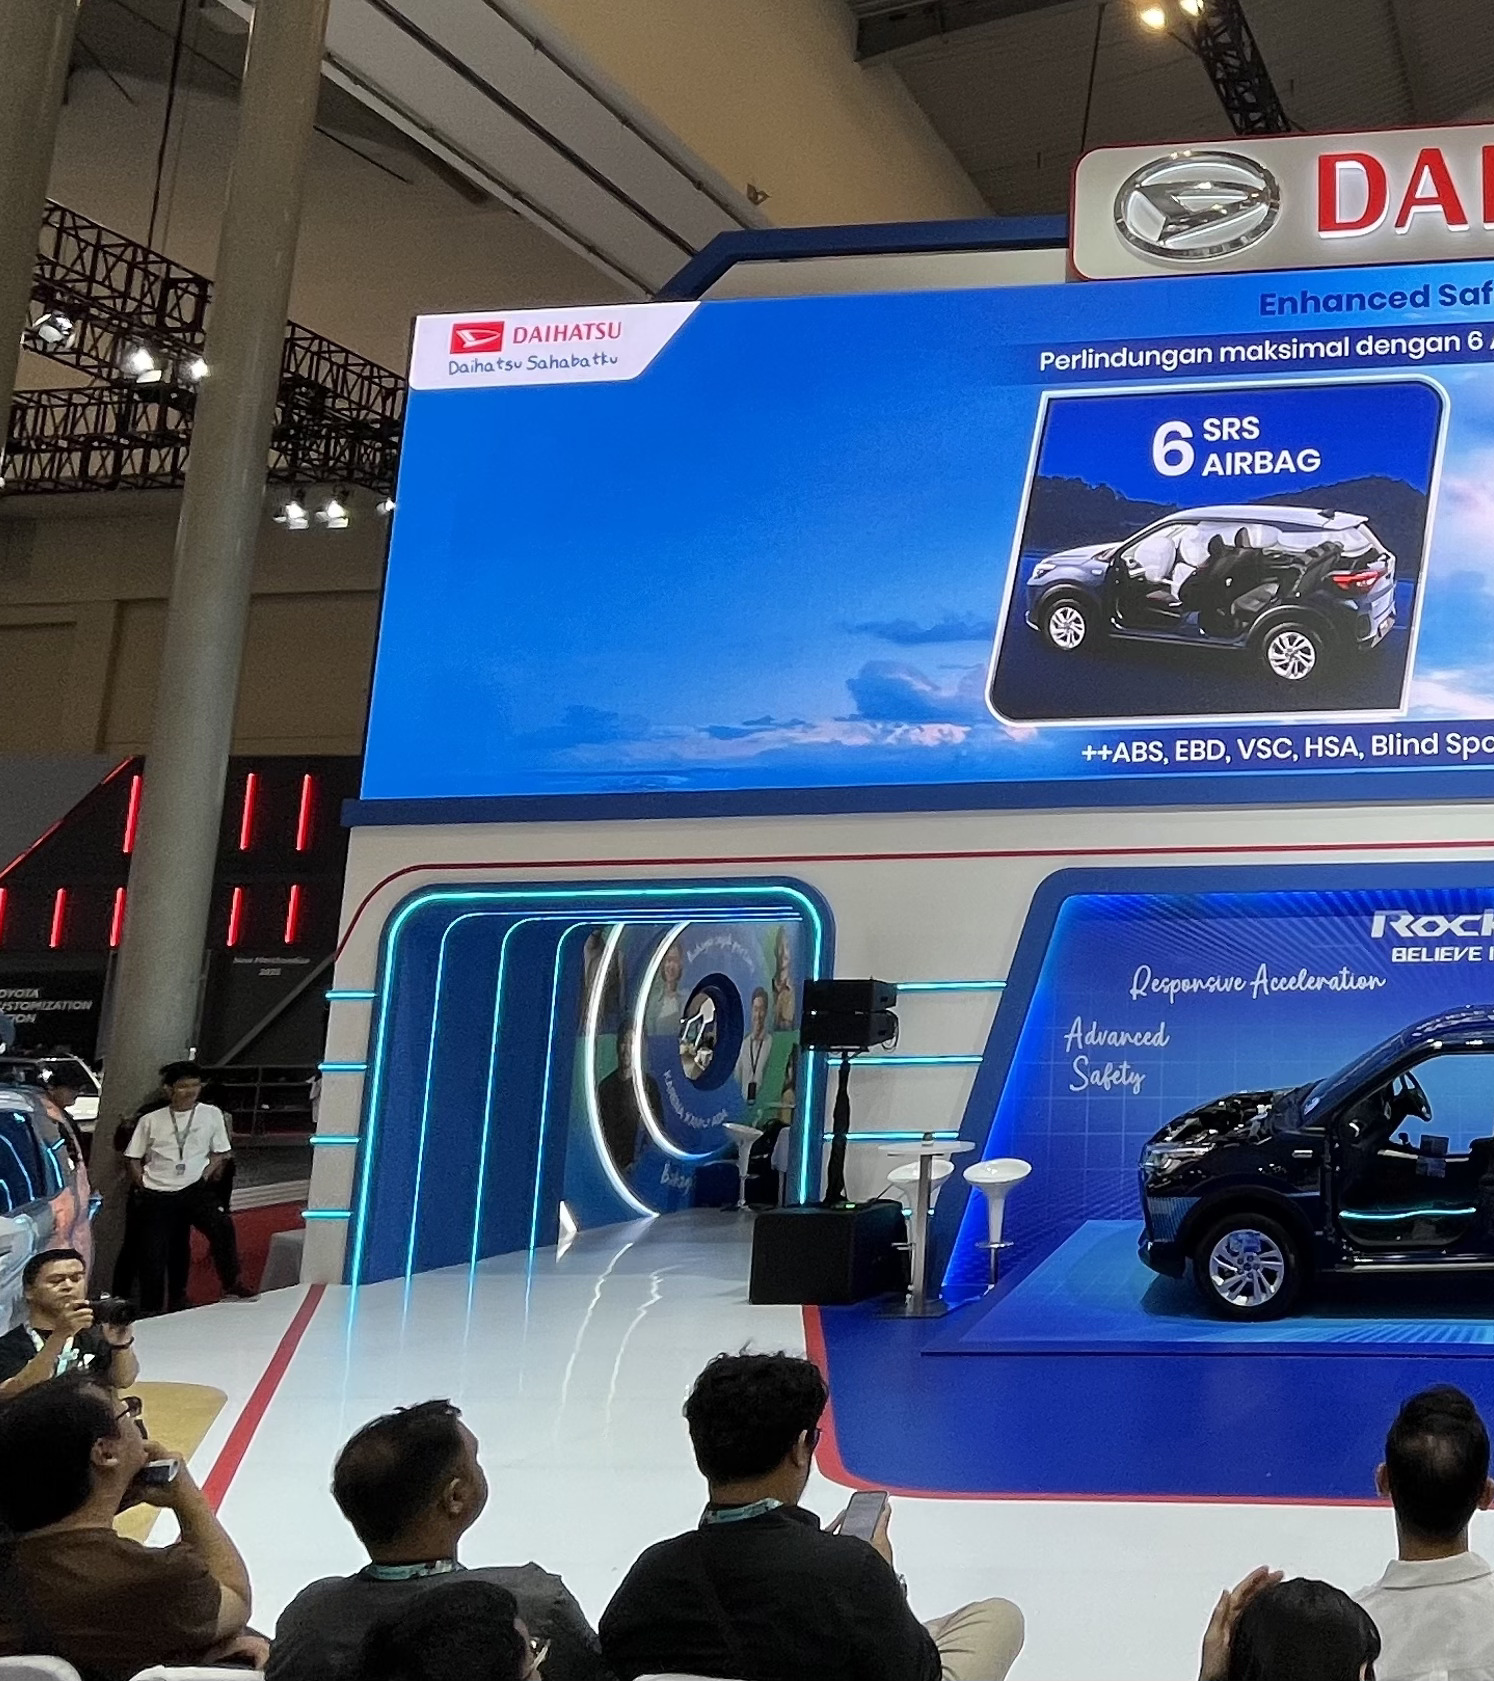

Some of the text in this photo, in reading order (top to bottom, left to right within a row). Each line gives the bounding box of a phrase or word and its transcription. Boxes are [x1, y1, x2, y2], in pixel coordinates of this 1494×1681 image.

[1259, 283, 1430, 316] Enhanced
[512, 322, 622, 344] DAIHATSU
[448, 351, 619, 376] Daihatsu Sahabatku
[1039, 346, 1213, 372] Perlindungan
[1219, 336, 1350, 362] maksimal
[1356, 335, 1460, 359] dengan
[1467, 330, 1484, 350] 6
[1203, 416, 1260, 441] SRS
[1152, 420, 1195, 476] 6
[1201, 448, 1321, 476] AIRBAG
[1081, 740, 1171, 765] ++ABS,
[1174, 738, 1232, 763] EBD,
[1236, 737, 1299, 762] VSC,
[1304, 735, 1365, 760] HSA,
[1371, 732, 1439, 756] Blind
[1391, 945, 1483, 963] BELIEVE
[0, 988, 39, 998] OYOTA
[1129, 963, 1387, 1004] Responsive Acceleration
[1063, 1015, 1171, 1053] Advanced
[1068, 1054, 1147, 1095] Safety
